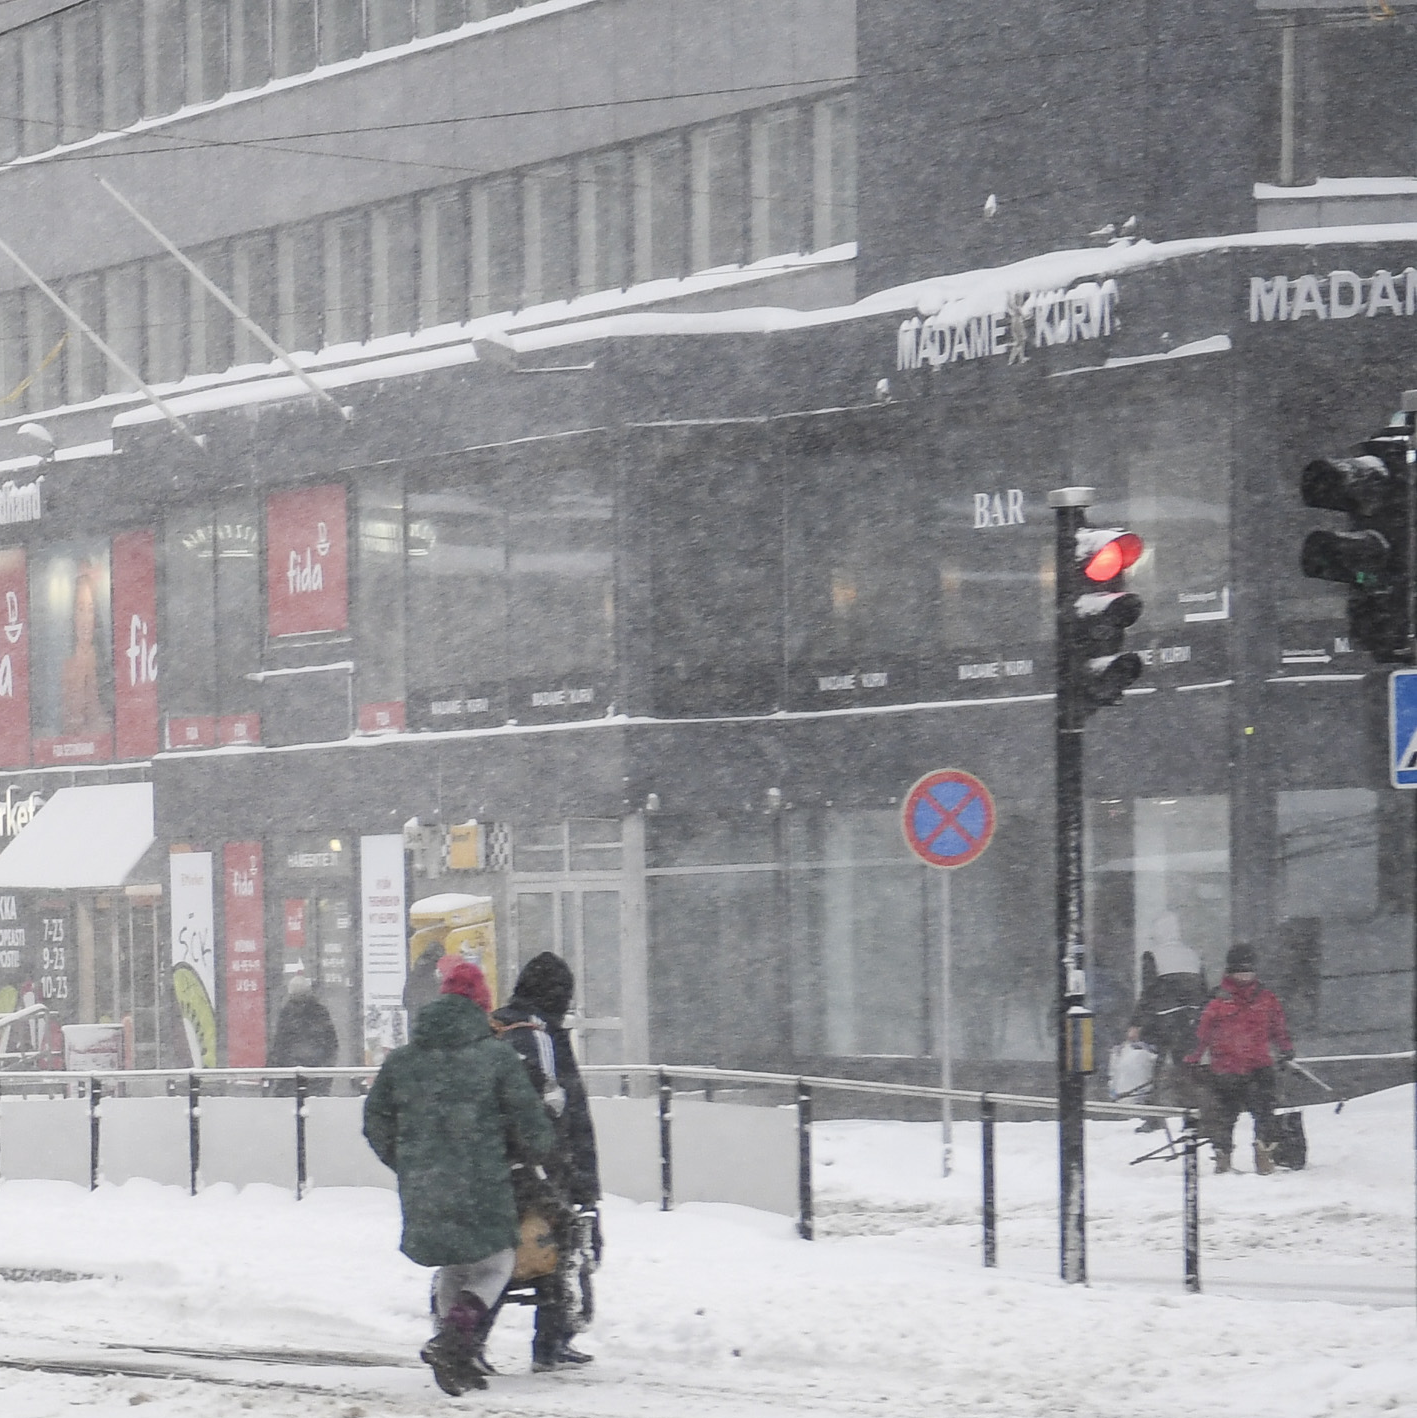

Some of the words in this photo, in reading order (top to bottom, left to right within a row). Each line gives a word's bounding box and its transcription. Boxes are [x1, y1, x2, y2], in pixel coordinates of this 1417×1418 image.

[897, 312, 1008, 371] MADAME
[973, 489, 1025, 529] BAR
[287, 547, 323, 594] fida
[43, 919, 64, 941] 7-23
[43, 947, 65, 970] 9-23
[41, 976, 68, 999] 10-23
